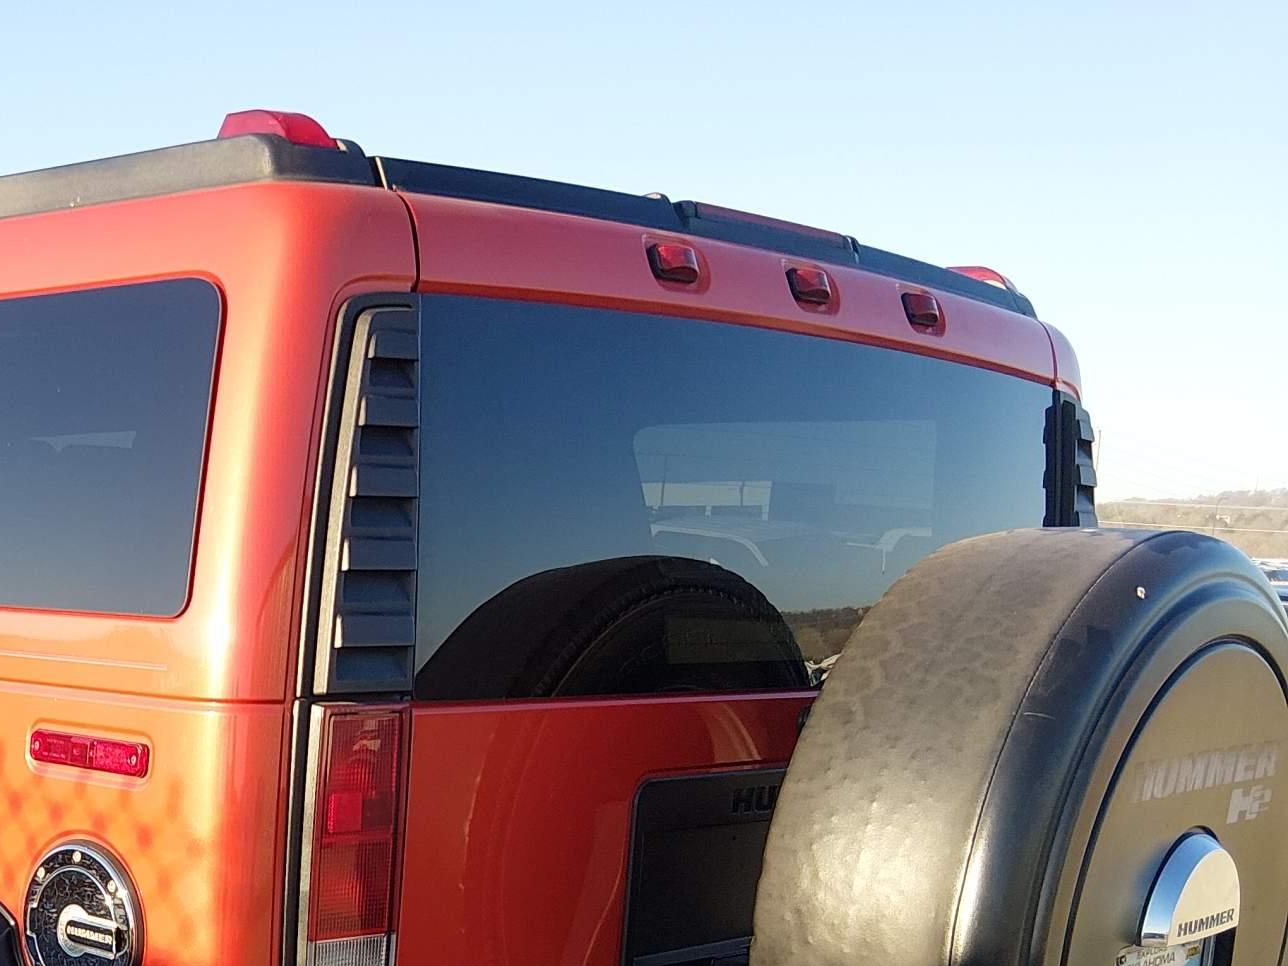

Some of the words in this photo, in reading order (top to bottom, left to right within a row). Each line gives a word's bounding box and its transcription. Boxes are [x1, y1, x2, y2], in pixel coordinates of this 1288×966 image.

[1226, 784, 1273, 824] H2
[66, 925, 113, 946] HUMMER
[1176, 908, 1235, 938] HUMMER
